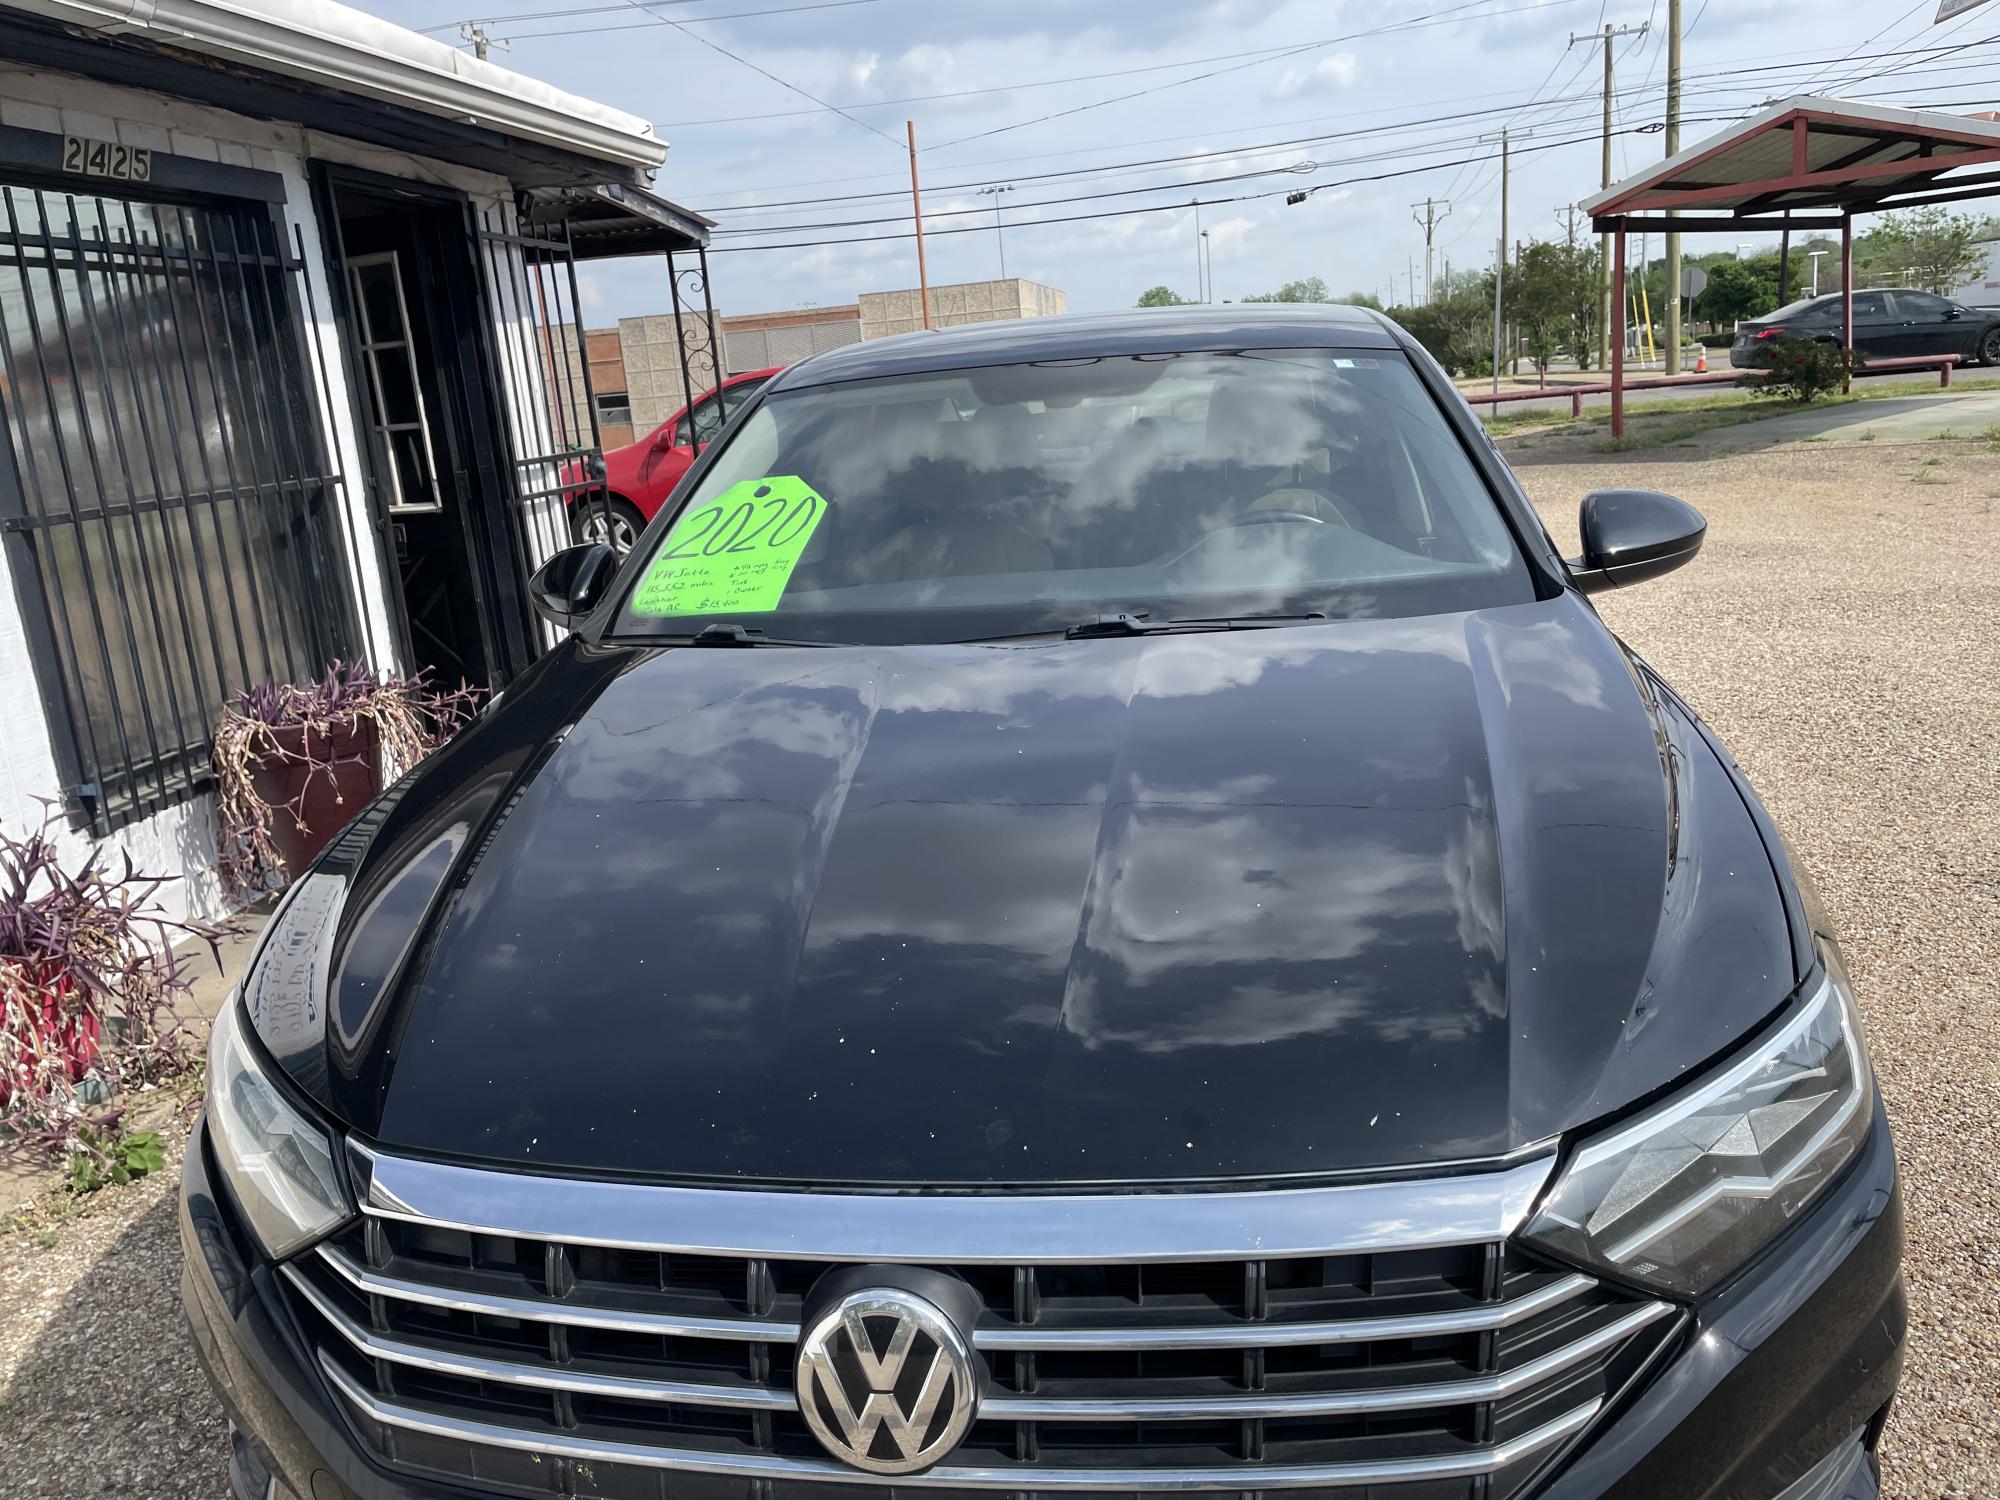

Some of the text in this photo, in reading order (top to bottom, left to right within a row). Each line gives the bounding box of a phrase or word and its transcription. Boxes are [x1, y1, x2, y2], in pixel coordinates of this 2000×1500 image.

[65, 138, 149, 180] 2425
[662, 496, 817, 560] 2020
[654, 570, 674, 580] VW
[734, 586, 762, 594] Owner
[802, 1298, 966, 1468] VW
